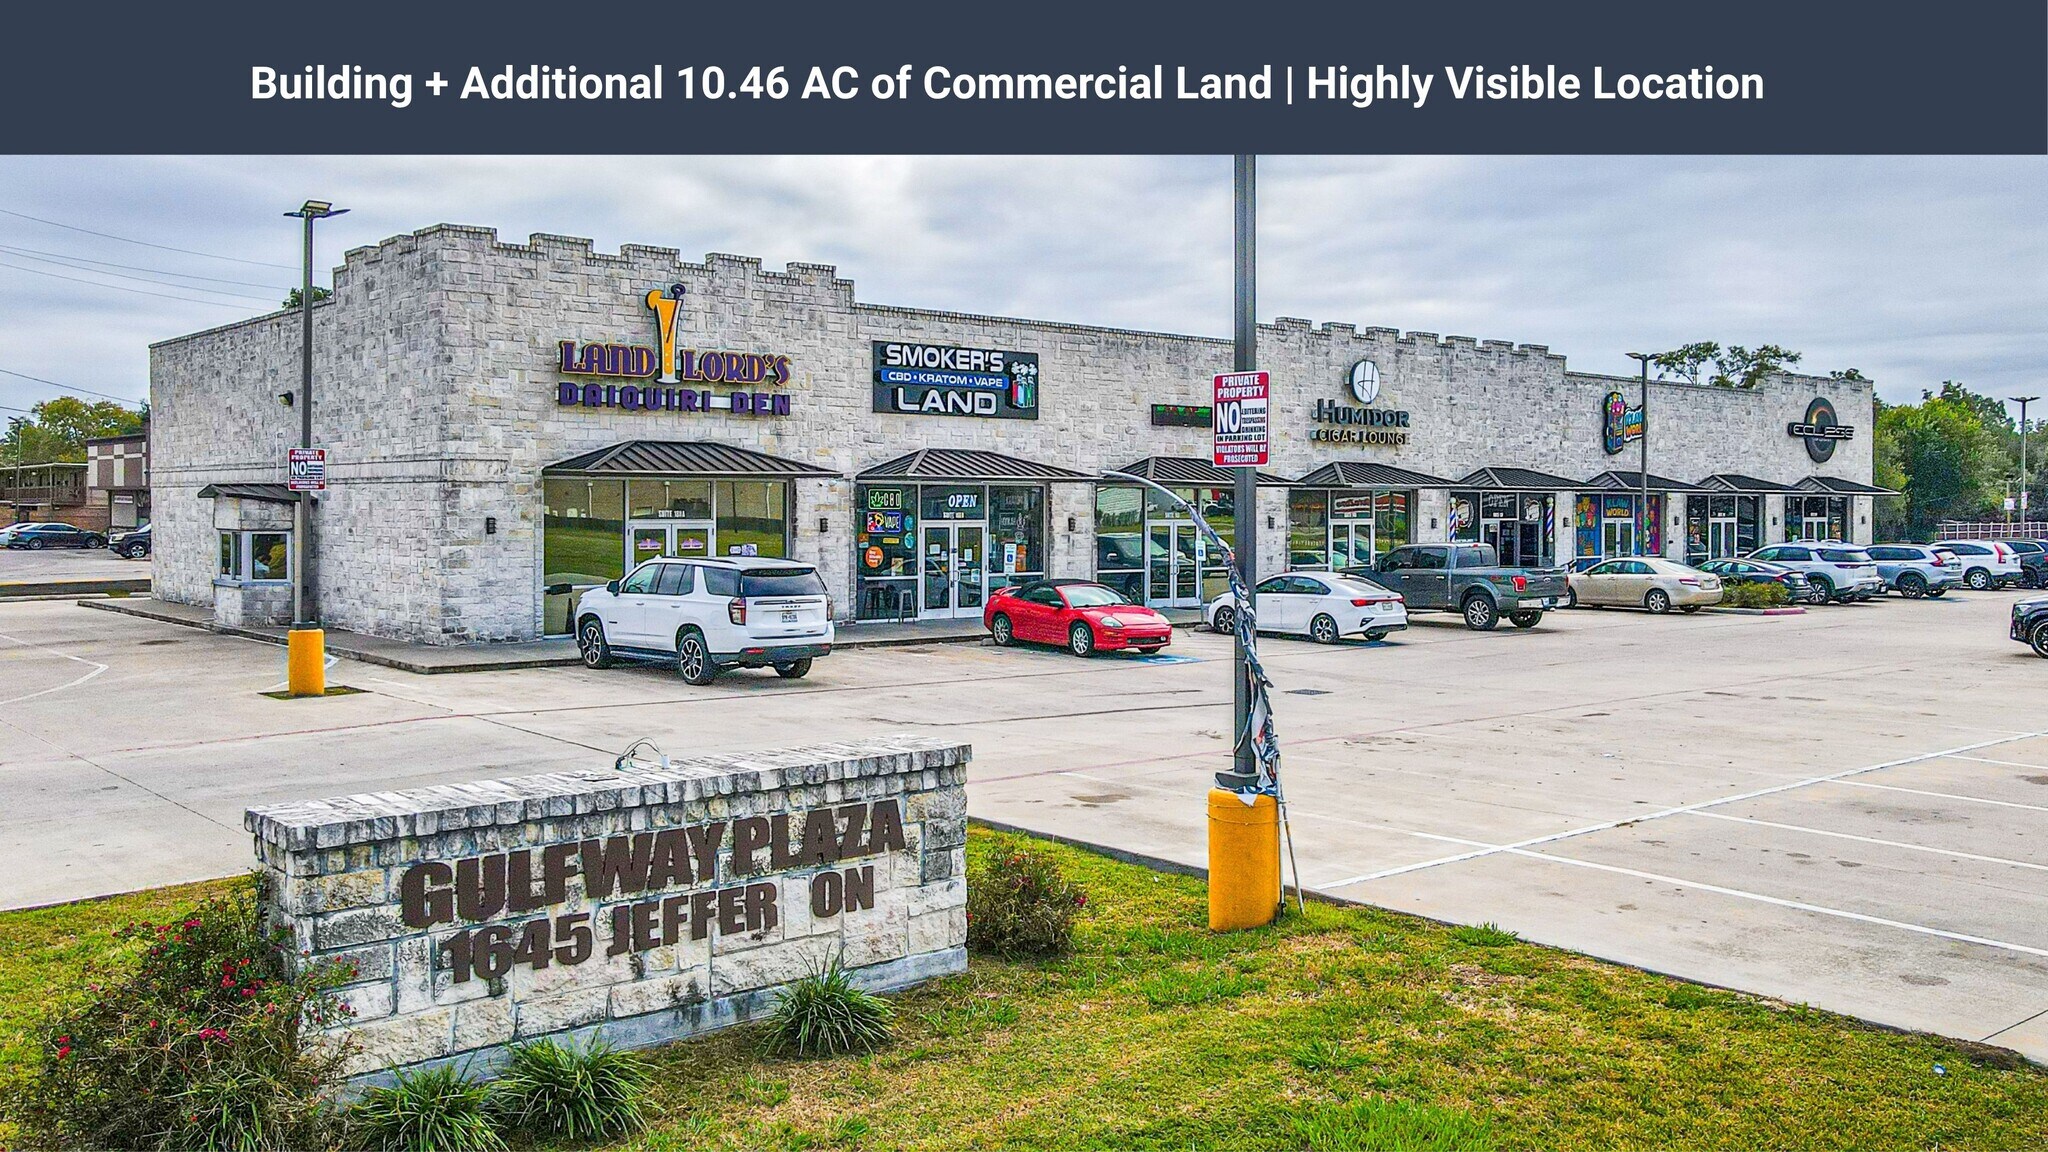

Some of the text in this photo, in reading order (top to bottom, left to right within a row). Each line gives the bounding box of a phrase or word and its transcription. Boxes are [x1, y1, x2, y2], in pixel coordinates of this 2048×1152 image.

[559, 341, 791, 386] LAND LORD'S
[886, 344, 1004, 372] SMOKER'S
[888, 371, 1003, 387] CBD KRATOM VAPE
[1217, 385, 1265, 398] PROPERTY
[1222, 374, 1260, 387] PRIVATE
[558, 382, 791, 416] DAIQUIRI DEN
[897, 388, 997, 415] LAND
[1216, 401, 1241, 433] NO
[1317, 398, 1411, 428] HUMIDOR
[1225, 434, 1253, 442] PARKING
[1254, 433, 1266, 441] LOT
[1317, 428, 1357, 443] CIGAR
[290, 461, 307, 475] NO
[948, 494, 978, 508] OPEN
[401, 799, 906, 930] GULFWAY PLAZA
[441, 913, 594, 985] 1645
